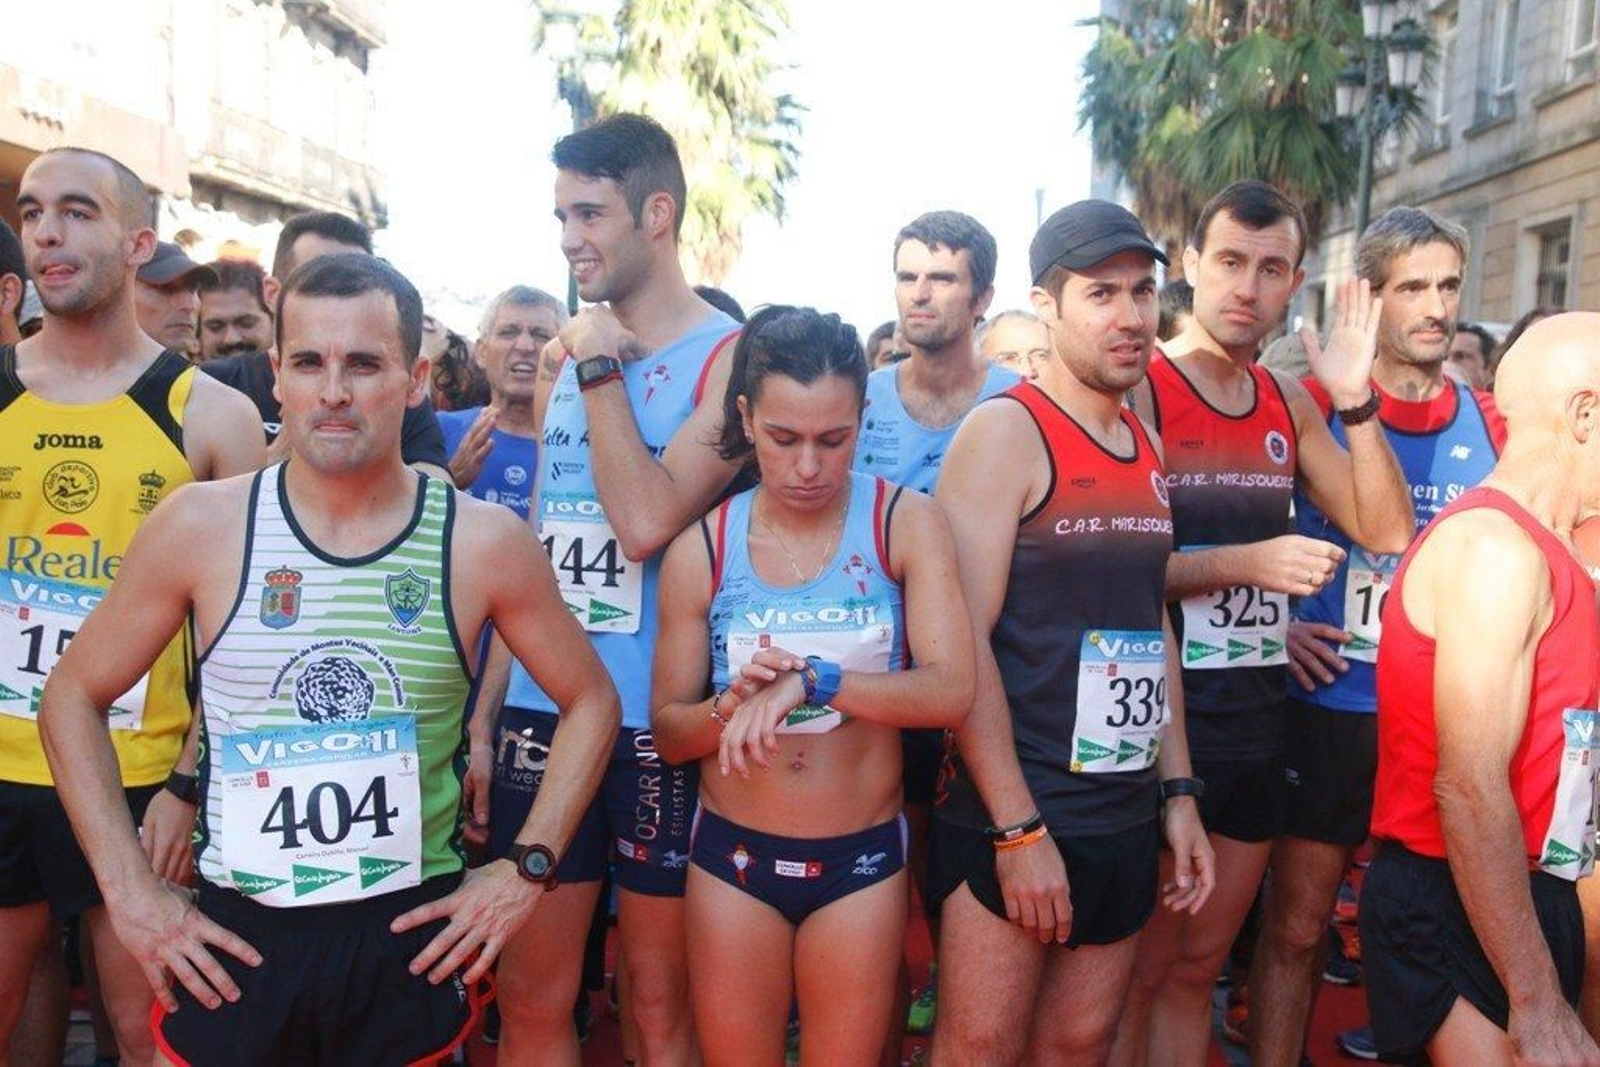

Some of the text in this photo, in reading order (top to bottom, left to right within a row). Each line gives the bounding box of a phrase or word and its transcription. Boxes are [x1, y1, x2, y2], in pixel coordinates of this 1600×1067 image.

[1408, 483, 1439, 501] en
[6, 536, 122, 580] Reale
[1209, 586, 1280, 629] 325
[1356, 584, 1390, 626] 1
[260, 775, 399, 850] 404
